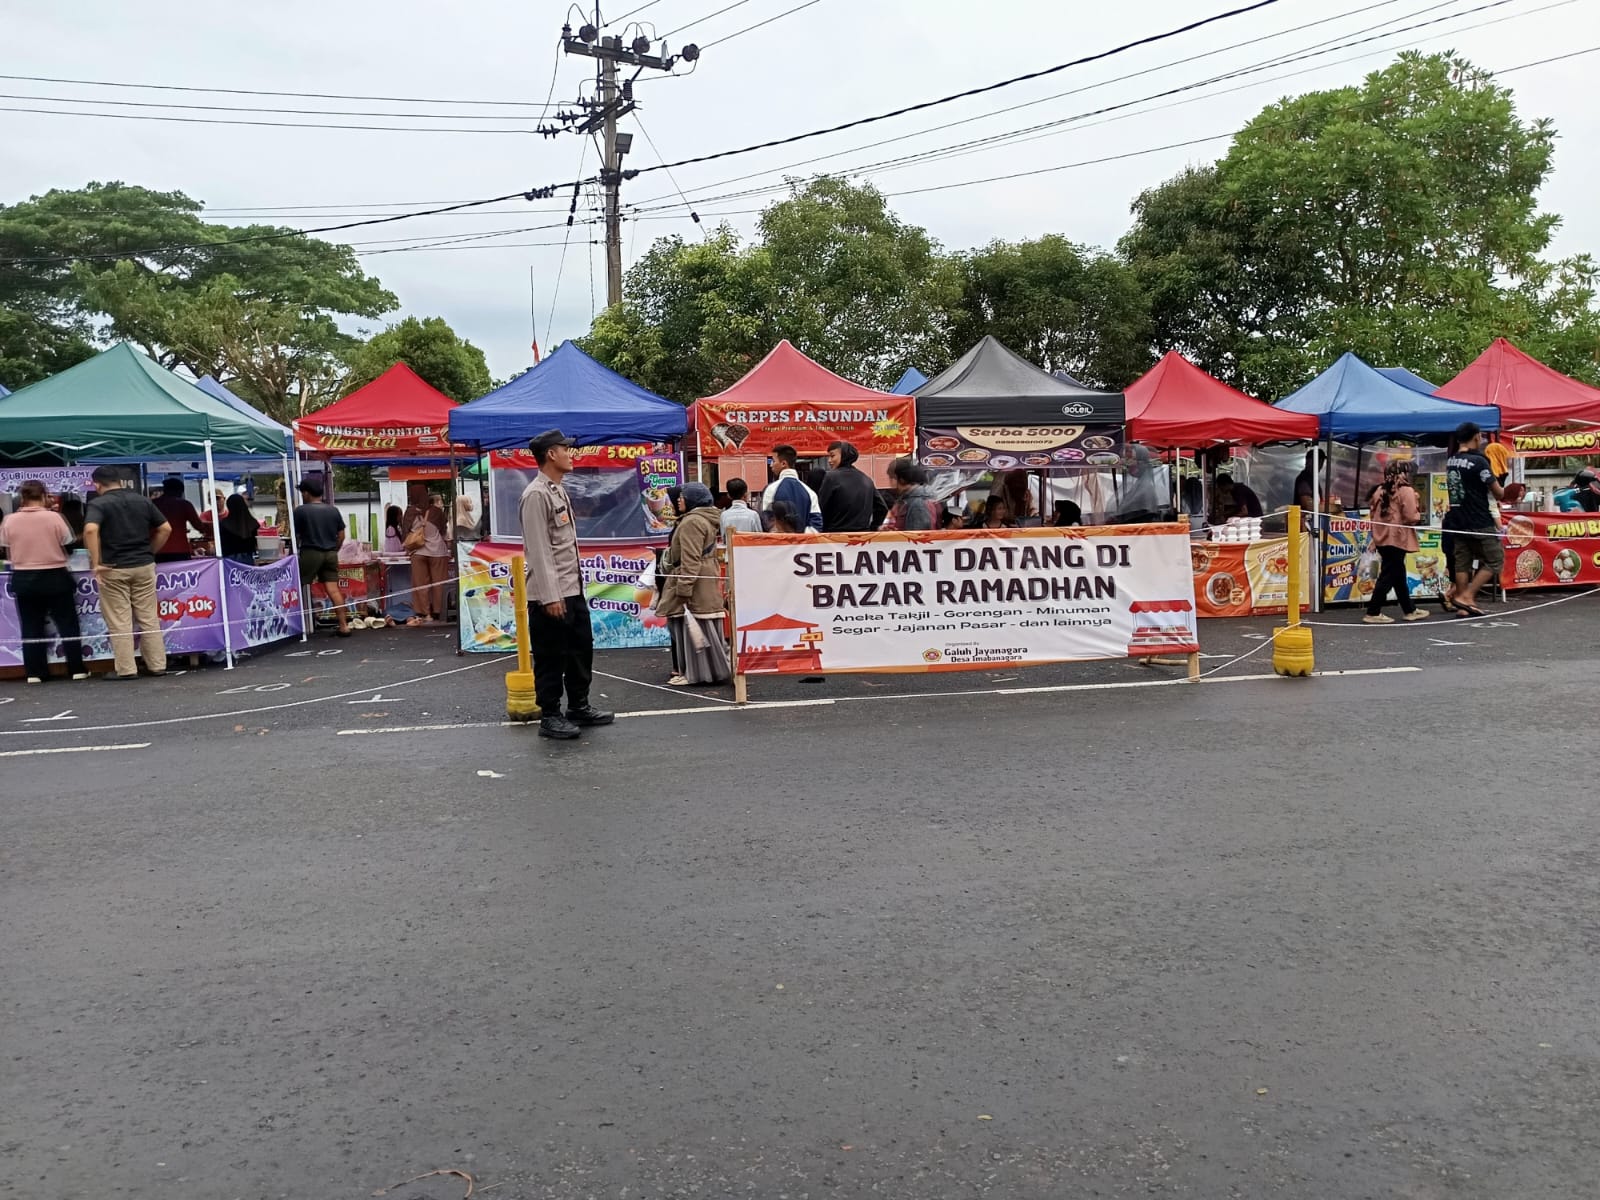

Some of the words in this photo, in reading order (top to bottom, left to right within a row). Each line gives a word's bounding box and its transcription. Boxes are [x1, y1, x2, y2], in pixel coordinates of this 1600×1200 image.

[725, 410, 789, 423] CREPES
[794, 409, 888, 422] PASUNDAN
[316, 425, 374, 437] PANGSIT
[378, 426, 432, 437] JONTOR
[968, 428, 1023, 437] Serba
[1026, 427, 1077, 437] 5000
[1515, 435, 1554, 451] TAHU
[1555, 433, 1596, 449] BASO
[640, 460, 650, 475] ES
[653, 458, 678, 474] TELER
[54, 470, 90, 480] CREAMY
[1330, 520, 1357, 532] TELOR
[1547, 522, 1586, 539] TAHU
[793, 548, 943, 577] SELAMAT
[954, 544, 1086, 573] DATANG
[1096, 544, 1131, 568] DI
[489, 562, 509, 579] Es
[812, 581, 924, 609] BAZAR
[936, 576, 1116, 604] RAMADHAN
[159, 602, 179, 615] 8K
[188, 599, 213, 613] 10K
[588, 597, 642, 617] Gemoy
[832, 613, 884, 622] Aneka
[887, 610, 930, 621] Takjil
[943, 608, 1023, 618] Gorengan
[1036, 606, 1111, 616] Minuman
[832, 625, 881, 636] Segar
[893, 623, 956, 634] Jajanan
[960, 621, 1007, 630] Pasar
[1019, 618, 1050, 628] dan
[1053, 617, 1112, 628] lainnya
[944, 647, 971, 656] Galuh
[974, 647, 1028, 656] Jayanagara
